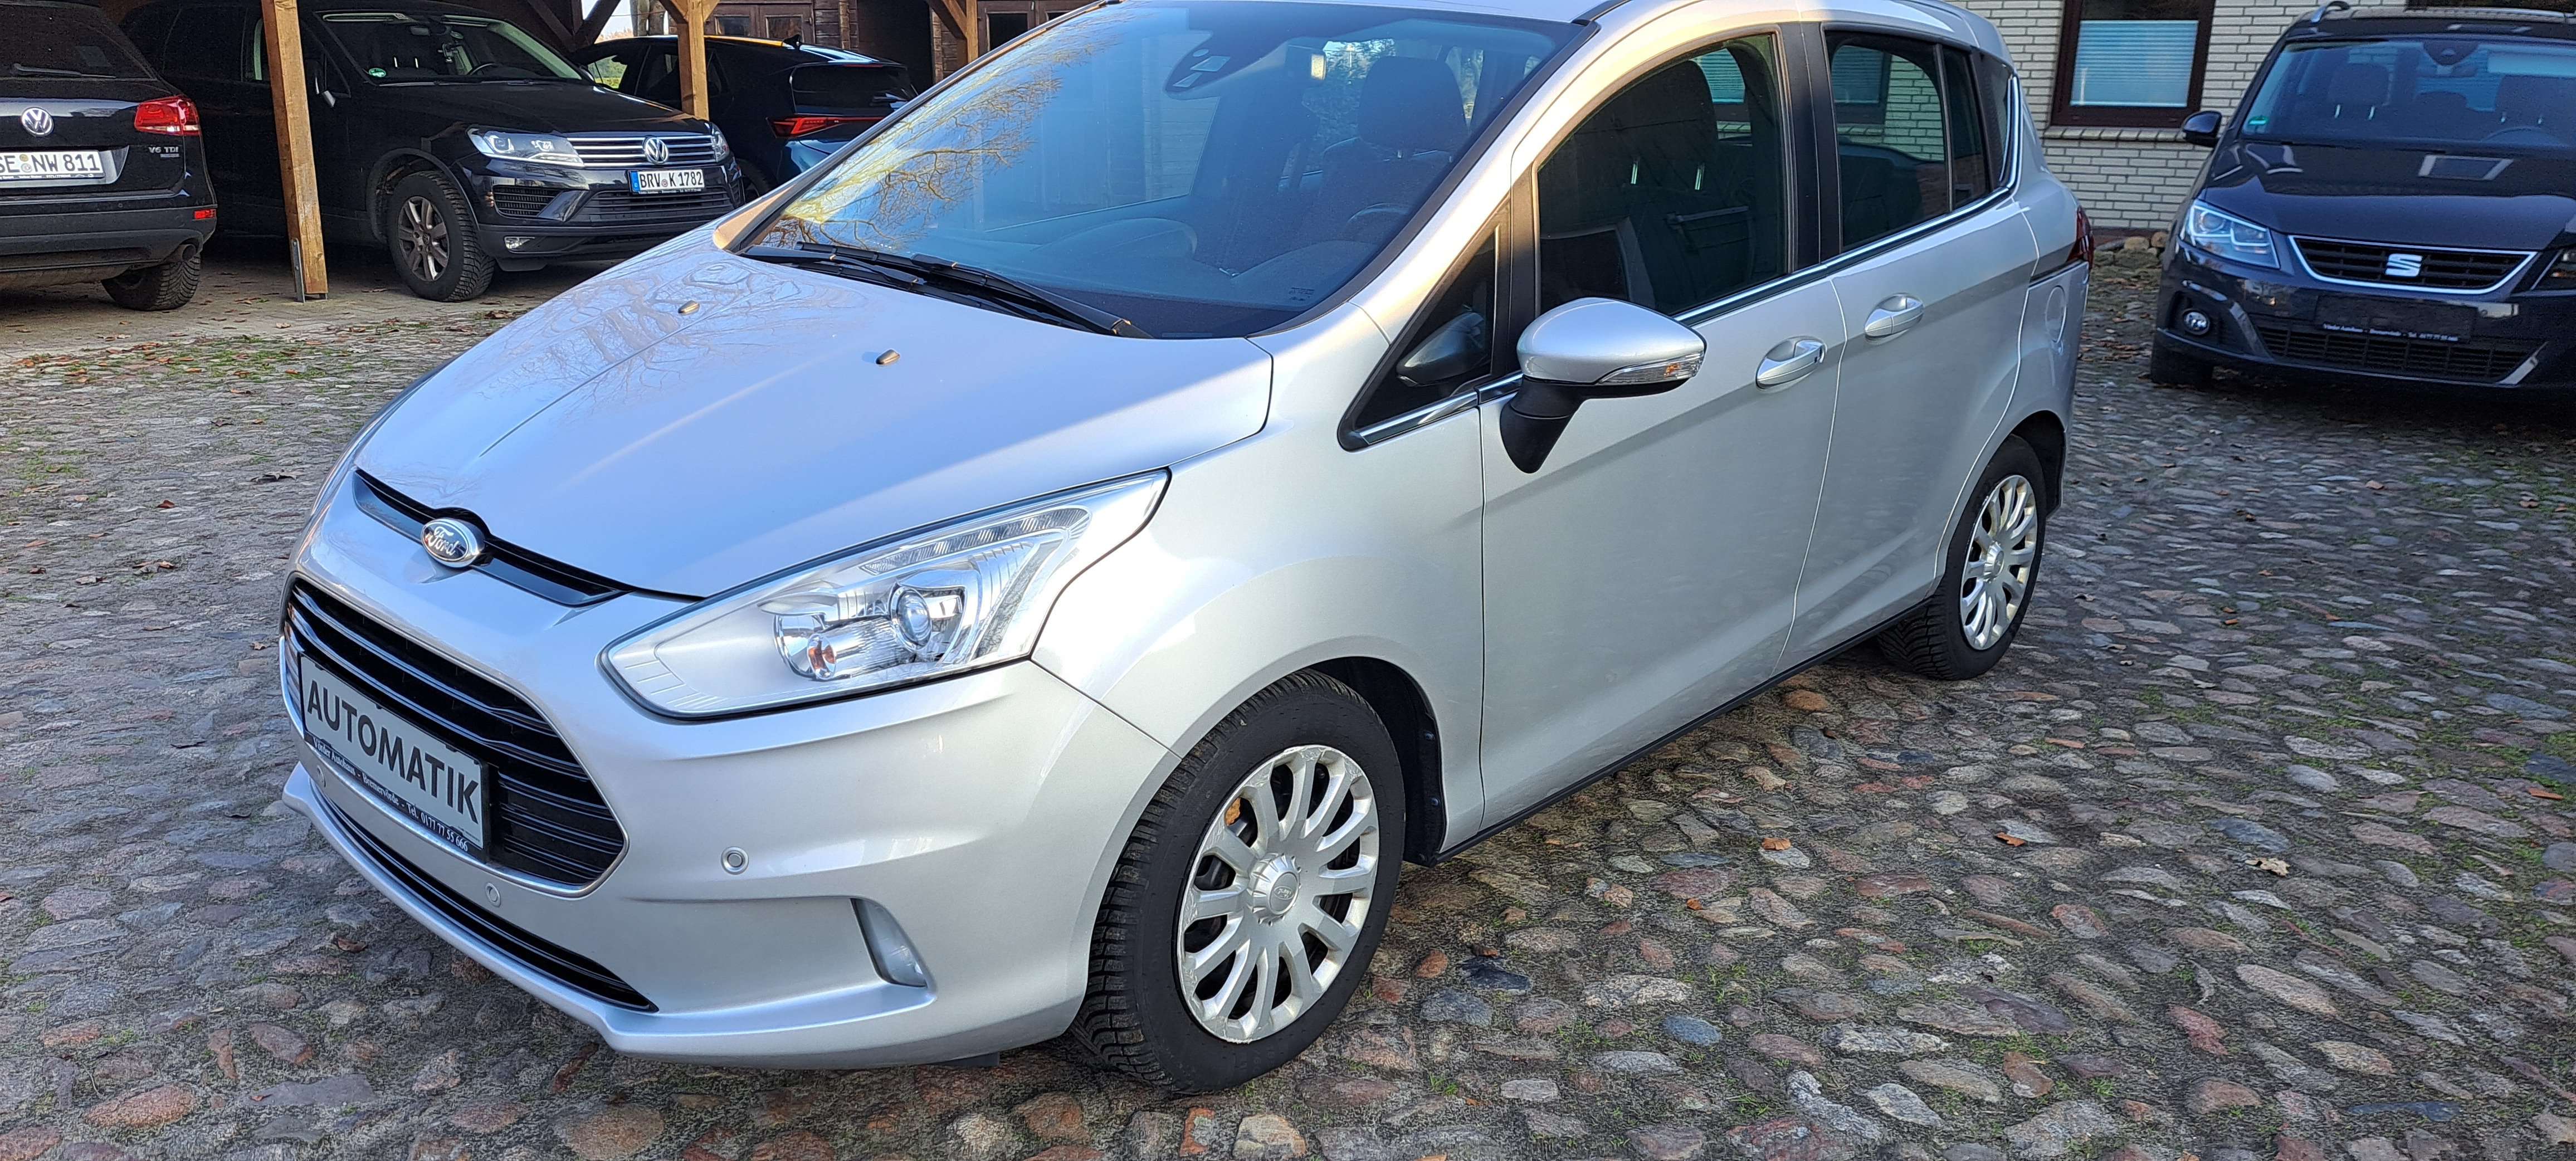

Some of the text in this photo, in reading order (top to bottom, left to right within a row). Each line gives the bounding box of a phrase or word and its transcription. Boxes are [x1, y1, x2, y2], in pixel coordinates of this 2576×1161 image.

[31, 154, 58, 172] NW
[63, 154, 100, 172] 811
[640, 171, 703, 188] BRV K 1782
[425, 525, 460, 556] Ford
[307, 680, 479, 825] AUTOMATIK
[331, 751, 356, 775] Autohaus
[406, 802, 419, 819] Tel.
[421, 812, 436, 831] 0177
[437, 823, 445, 836] 77
[446, 829, 454, 843] 55
[456, 836, 468, 852] 666
